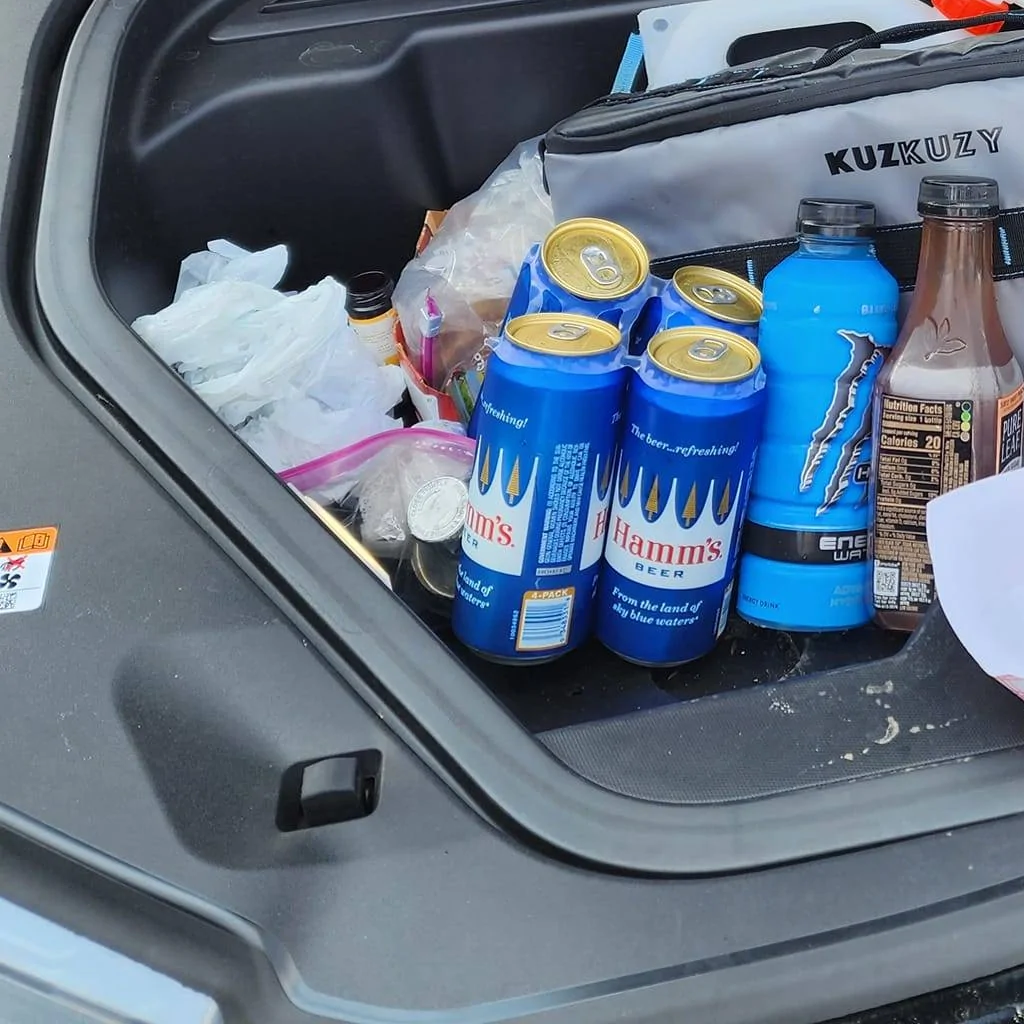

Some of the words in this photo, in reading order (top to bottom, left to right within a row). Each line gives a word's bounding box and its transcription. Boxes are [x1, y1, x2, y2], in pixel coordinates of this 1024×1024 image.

[825, 126, 1003, 176] KUZKUZY
[480, 392, 529, 430] refreshing!
[884, 398, 919, 414] Nutrition
[919, 402, 943, 414] Facts
[904, 414, 917, 423] size
[1003, 408, 1022, 442] PURE
[630, 423, 646, 441] The
[880, 434, 918, 448] Calories
[925, 435, 941, 449] 20
[1001, 430, 1021, 463] LEAF
[466, 503, 514, 547] mm's
[819, 535, 868, 551] ENE
[833, 549, 868, 562] WAT
[634, 562, 685, 578] BEER
[482, 584, 494, 598] of
[612, 586, 638, 607] From
[640, 599, 658, 613] the
[659, 601, 687, 614] land
[689, 600, 703, 614] of
[612, 603, 629, 619] sky
[629, 608, 653, 625] blue
